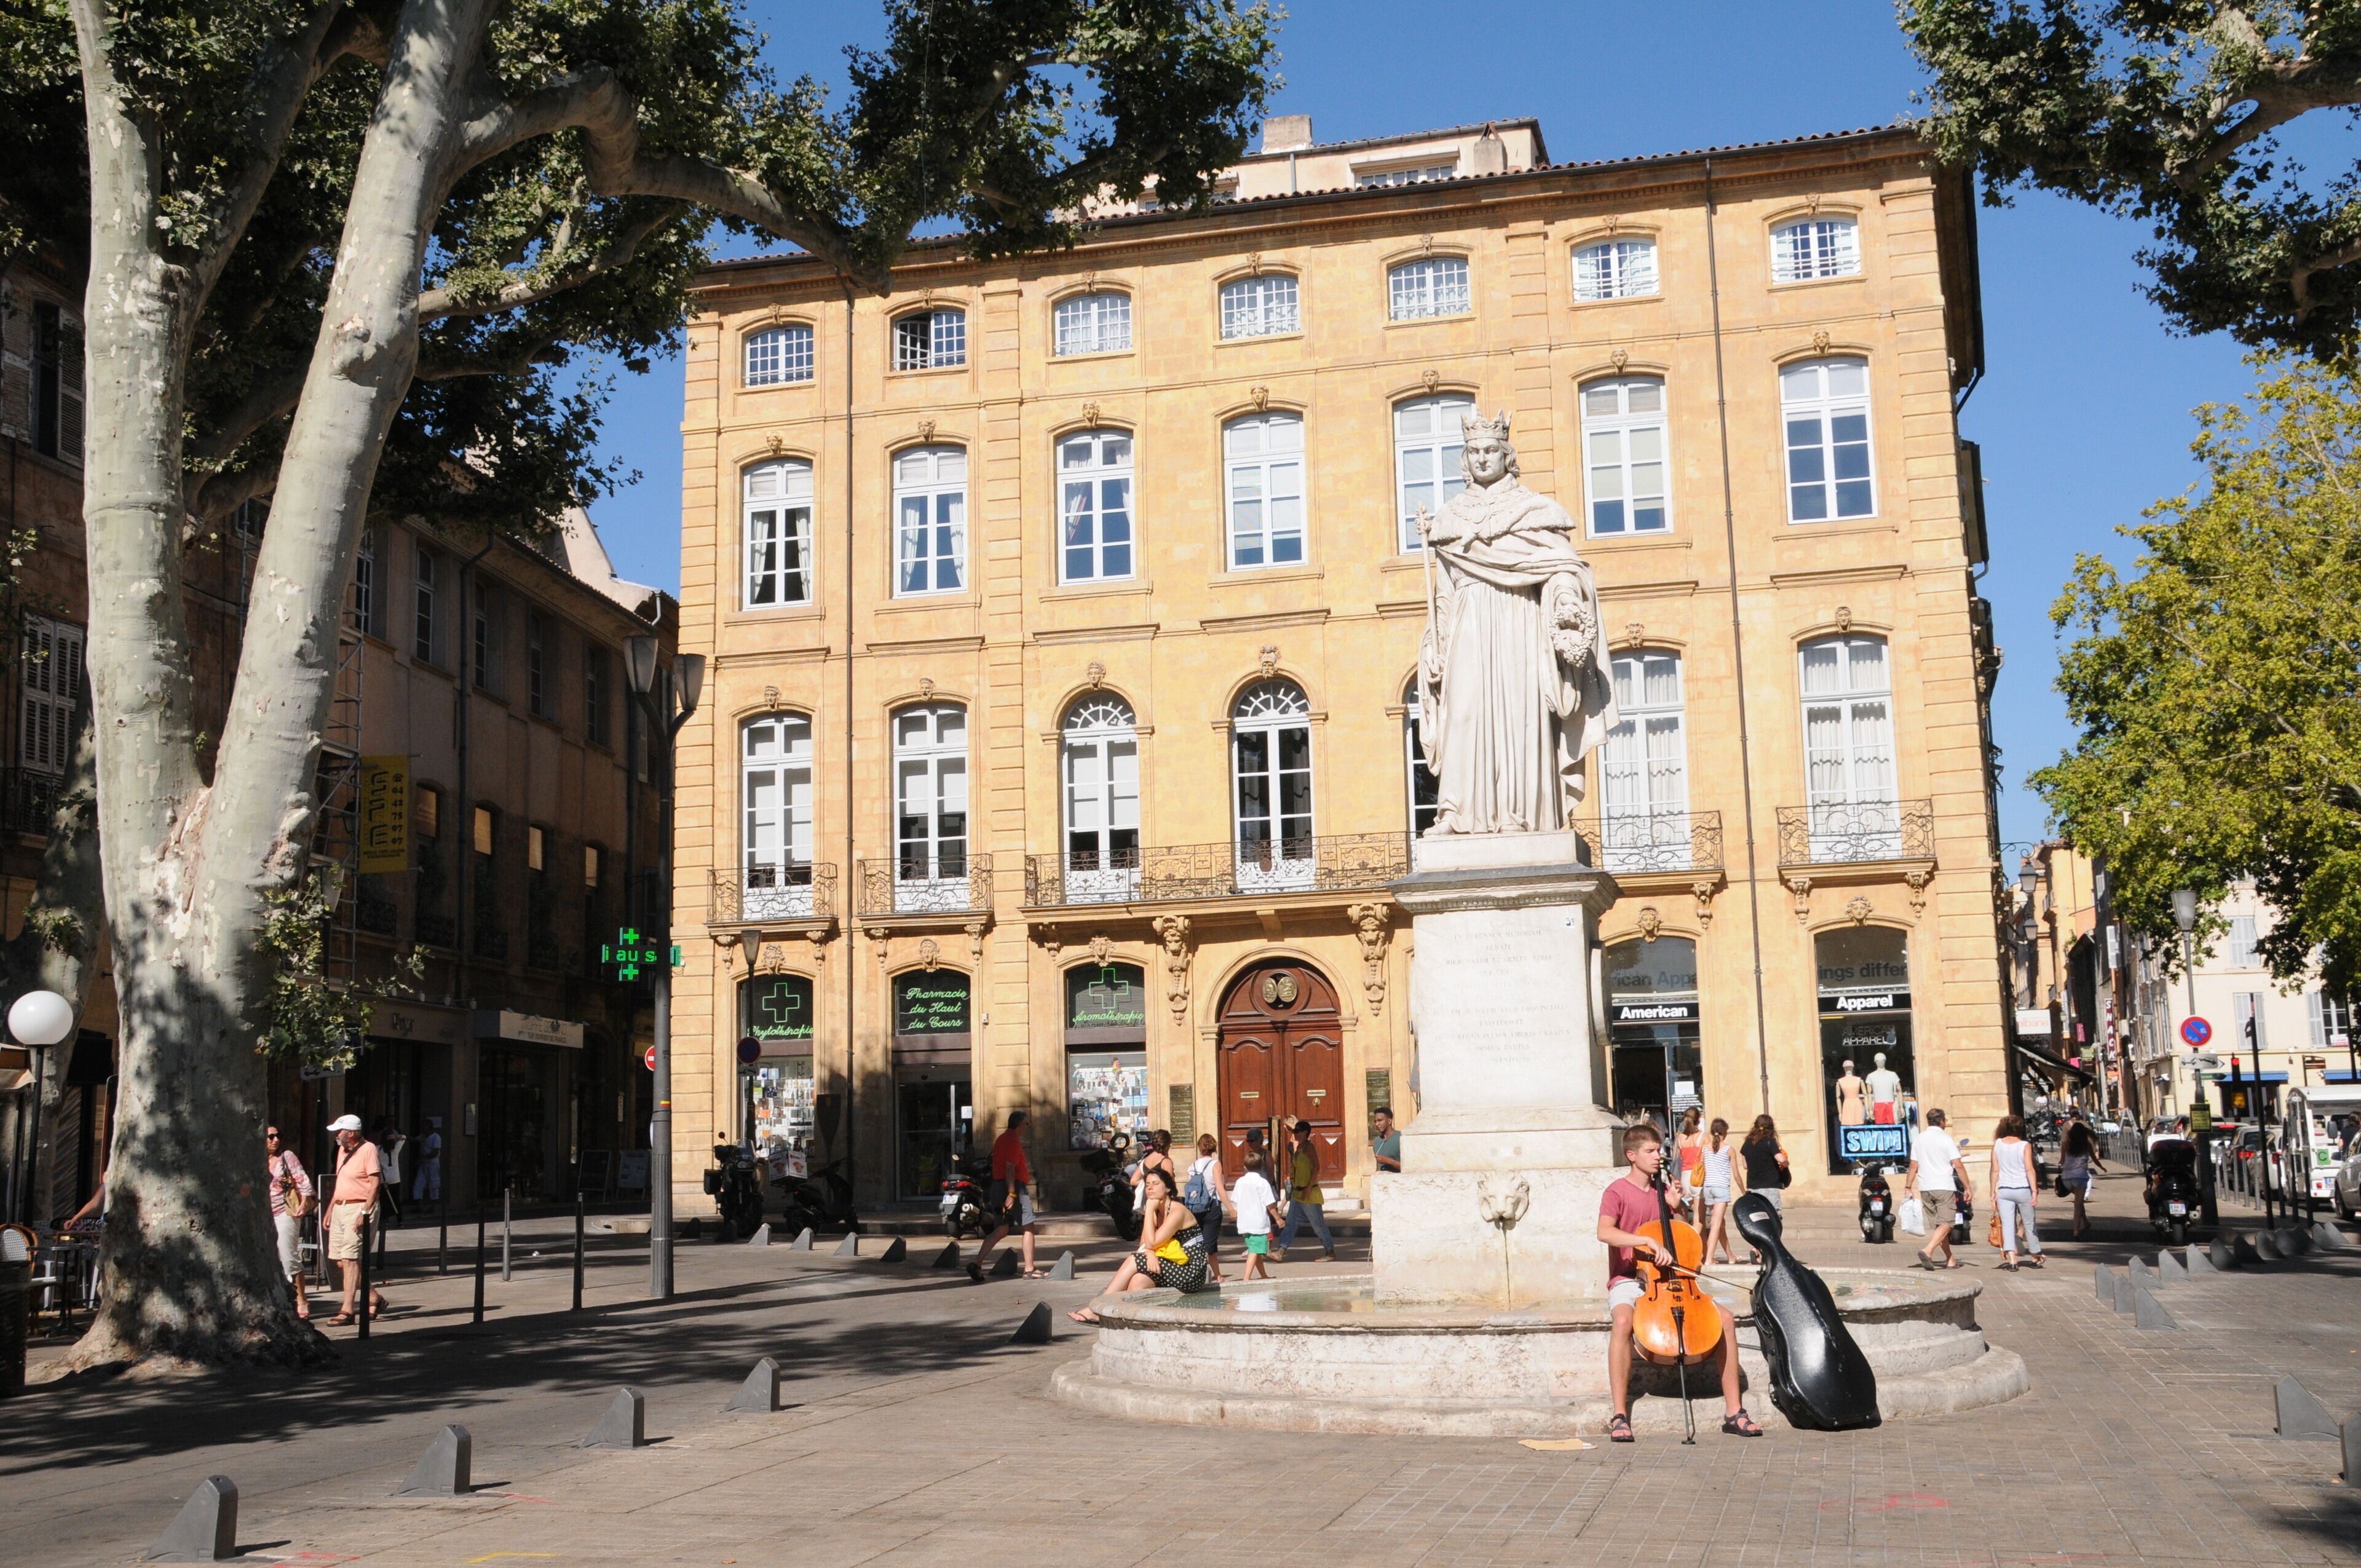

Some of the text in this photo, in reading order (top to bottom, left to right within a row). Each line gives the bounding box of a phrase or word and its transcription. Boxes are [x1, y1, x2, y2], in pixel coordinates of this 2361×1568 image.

[391, 798, 404, 807] 42
[391, 837, 403, 845] 07
[615, 949, 638, 961] au
[906, 988, 967, 999] Pharmacie
[910, 1001, 962, 1013] du Haut
[1837, 994, 1893, 1011] Apparel
[1072, 1009, 1145, 1024] Aromathérapie
[1620, 1005, 1688, 1019] American
[908, 1016, 963, 1029] du Cours
[2105, 1000, 2116, 1059] SNACK
[1847, 1130, 1902, 1152] SWIM
[2317, 1151, 2328, 1161] C
